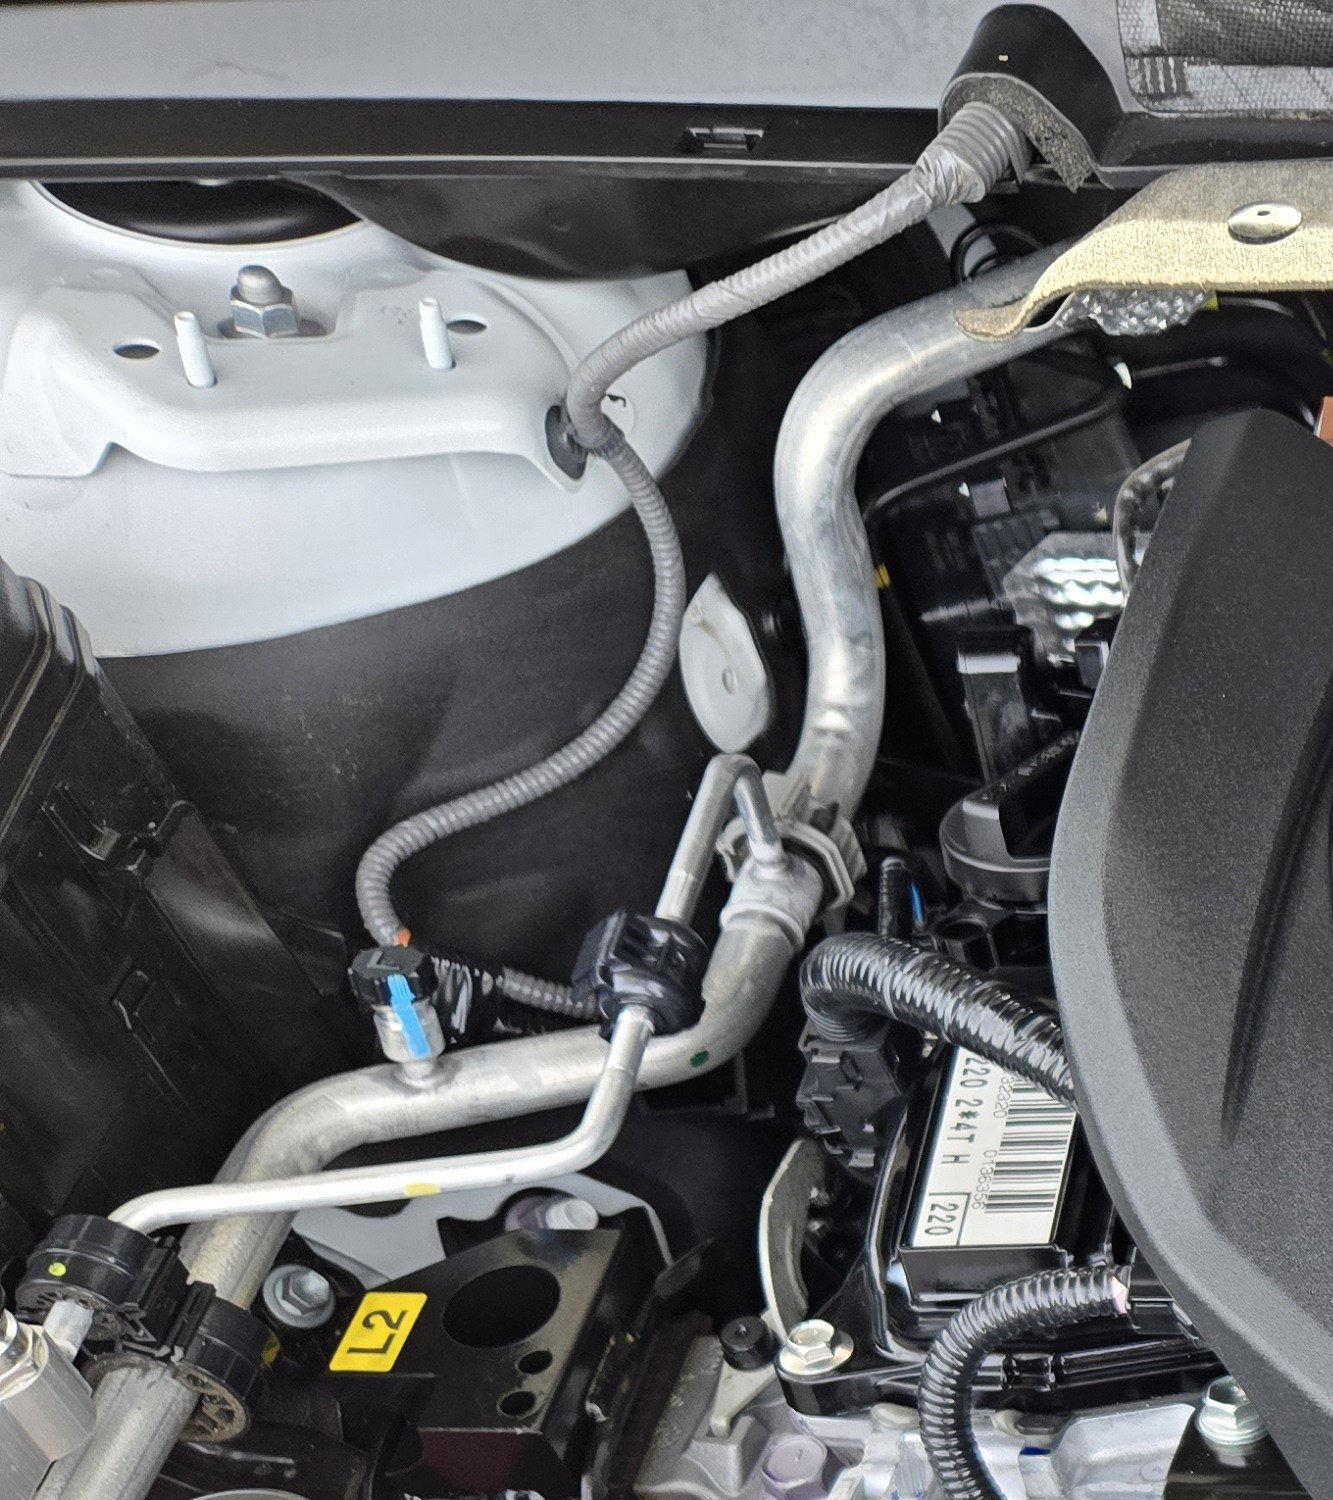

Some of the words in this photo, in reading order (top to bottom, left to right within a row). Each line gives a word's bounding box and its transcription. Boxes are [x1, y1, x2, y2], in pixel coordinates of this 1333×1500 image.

[972, 1149, 998, 1212] 0136356
[925, 1202, 957, 1238] 220
[347, 1306, 408, 1357] L2
